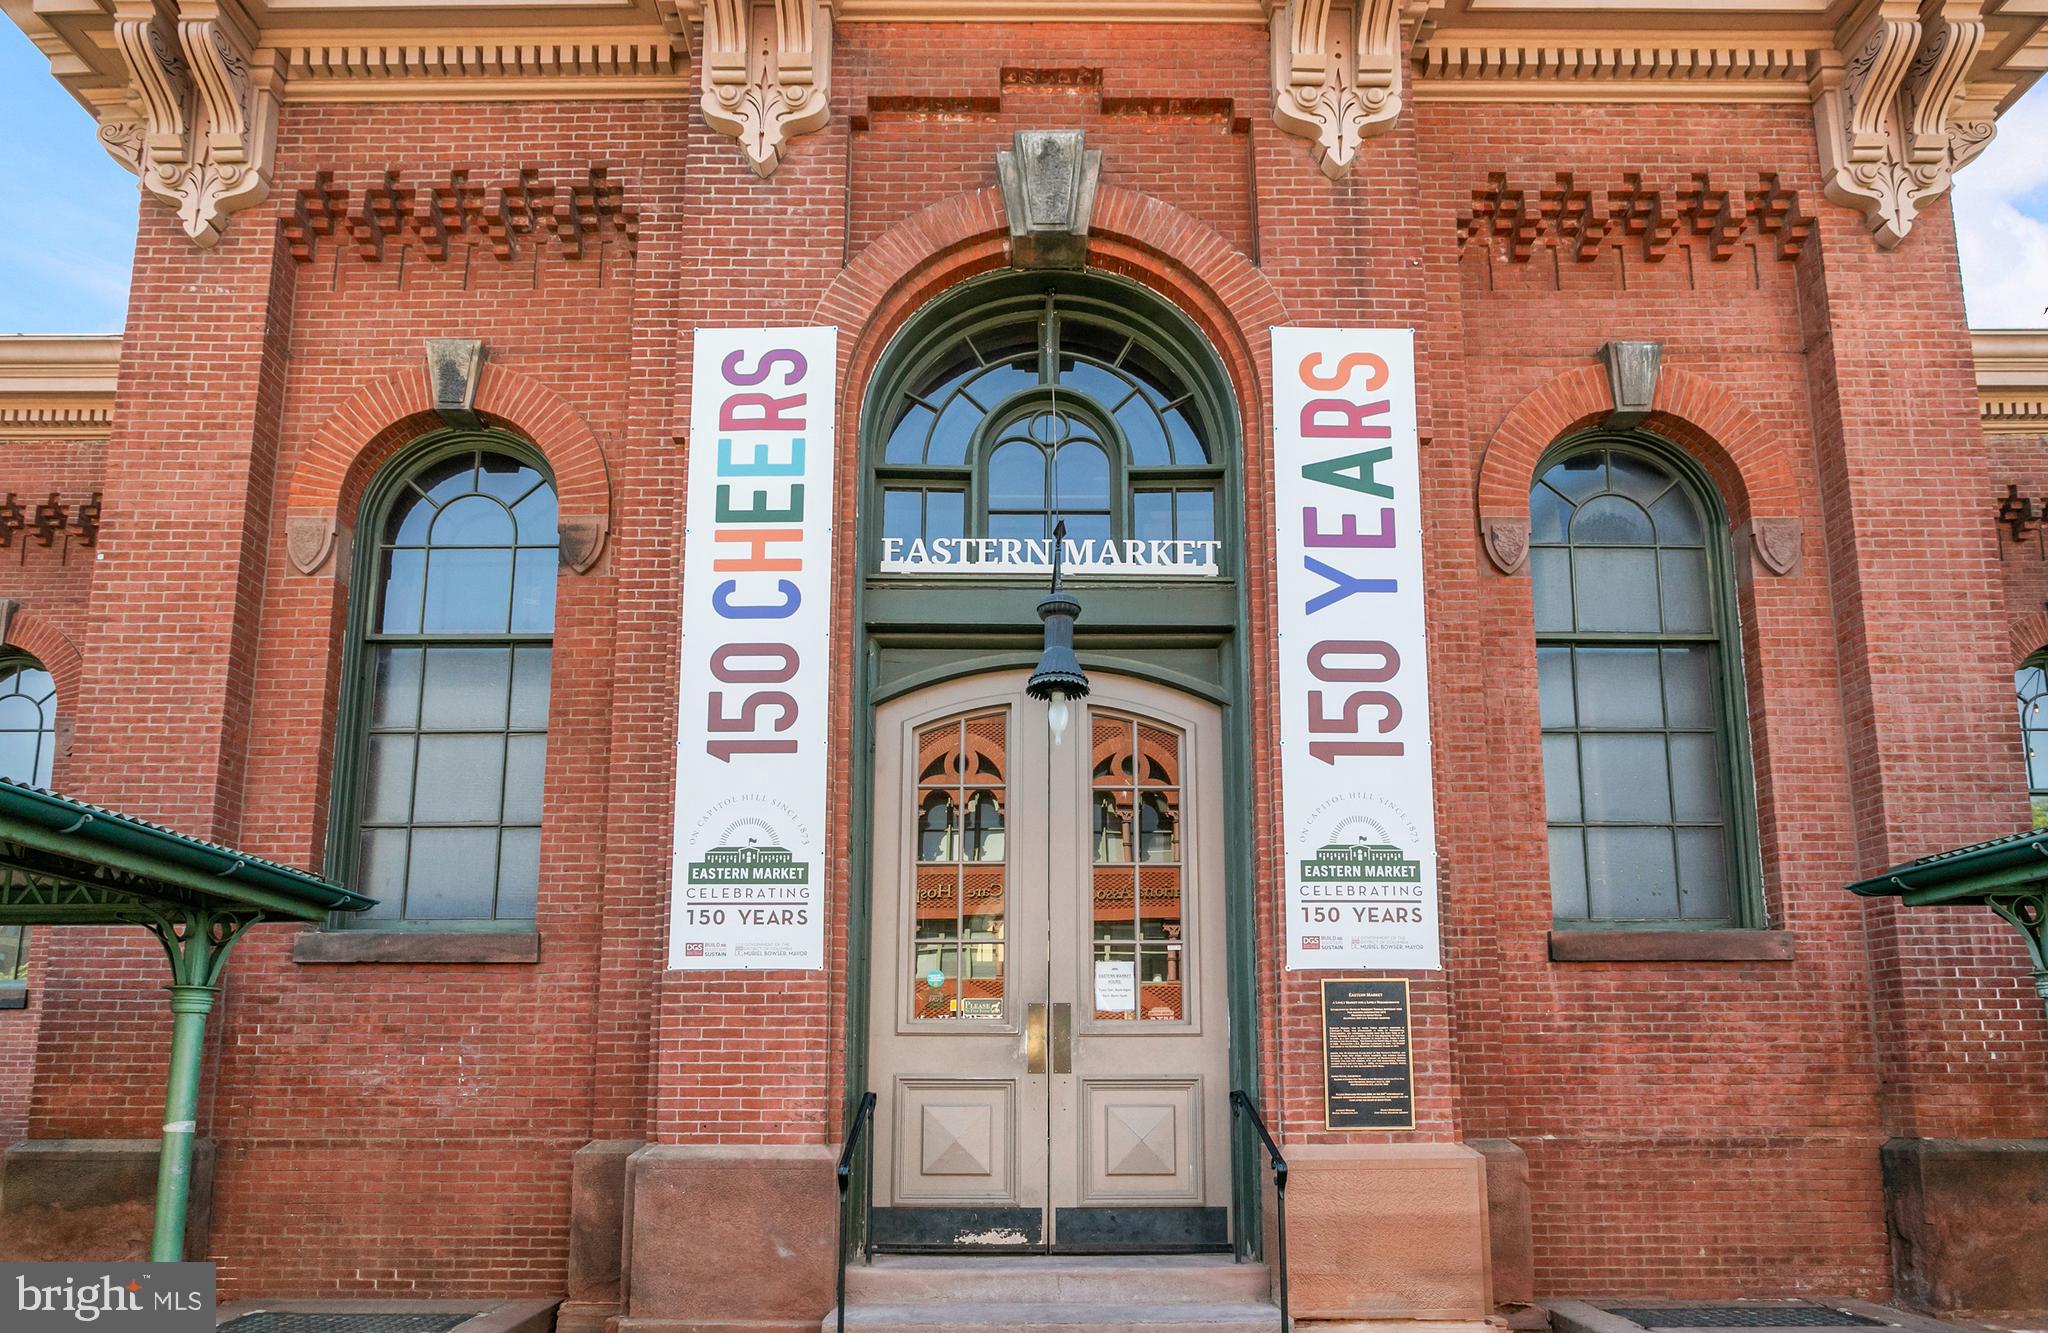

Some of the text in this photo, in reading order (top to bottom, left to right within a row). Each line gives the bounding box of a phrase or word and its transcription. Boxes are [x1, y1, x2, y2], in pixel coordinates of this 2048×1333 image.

[706, 348, 808, 763] 150 CHEERS
[881, 537, 1221, 567] EASTERN MARKET
[1298, 351, 1405, 766] 150 YEARS
[698, 796, 737, 828] CAPITOL
[741, 793, 767, 802] HILL
[771, 798, 799, 821] SINCE
[1308, 794, 1343, 826] CAPITOL
[1349, 791, 1375, 801] HILL
[1379, 796, 1408, 820] SINCE
[692, 867, 805, 880] EASTERN MARKET
[1305, 865, 1416, 878] EASTERN MARKET
[686, 887, 810, 899] CELEBRATING
[1299, 885, 1423, 897] CELEBRATING
[686, 909, 808, 925] 150 YEARS
[1301, 907, 1423, 923] 150 YEARS
